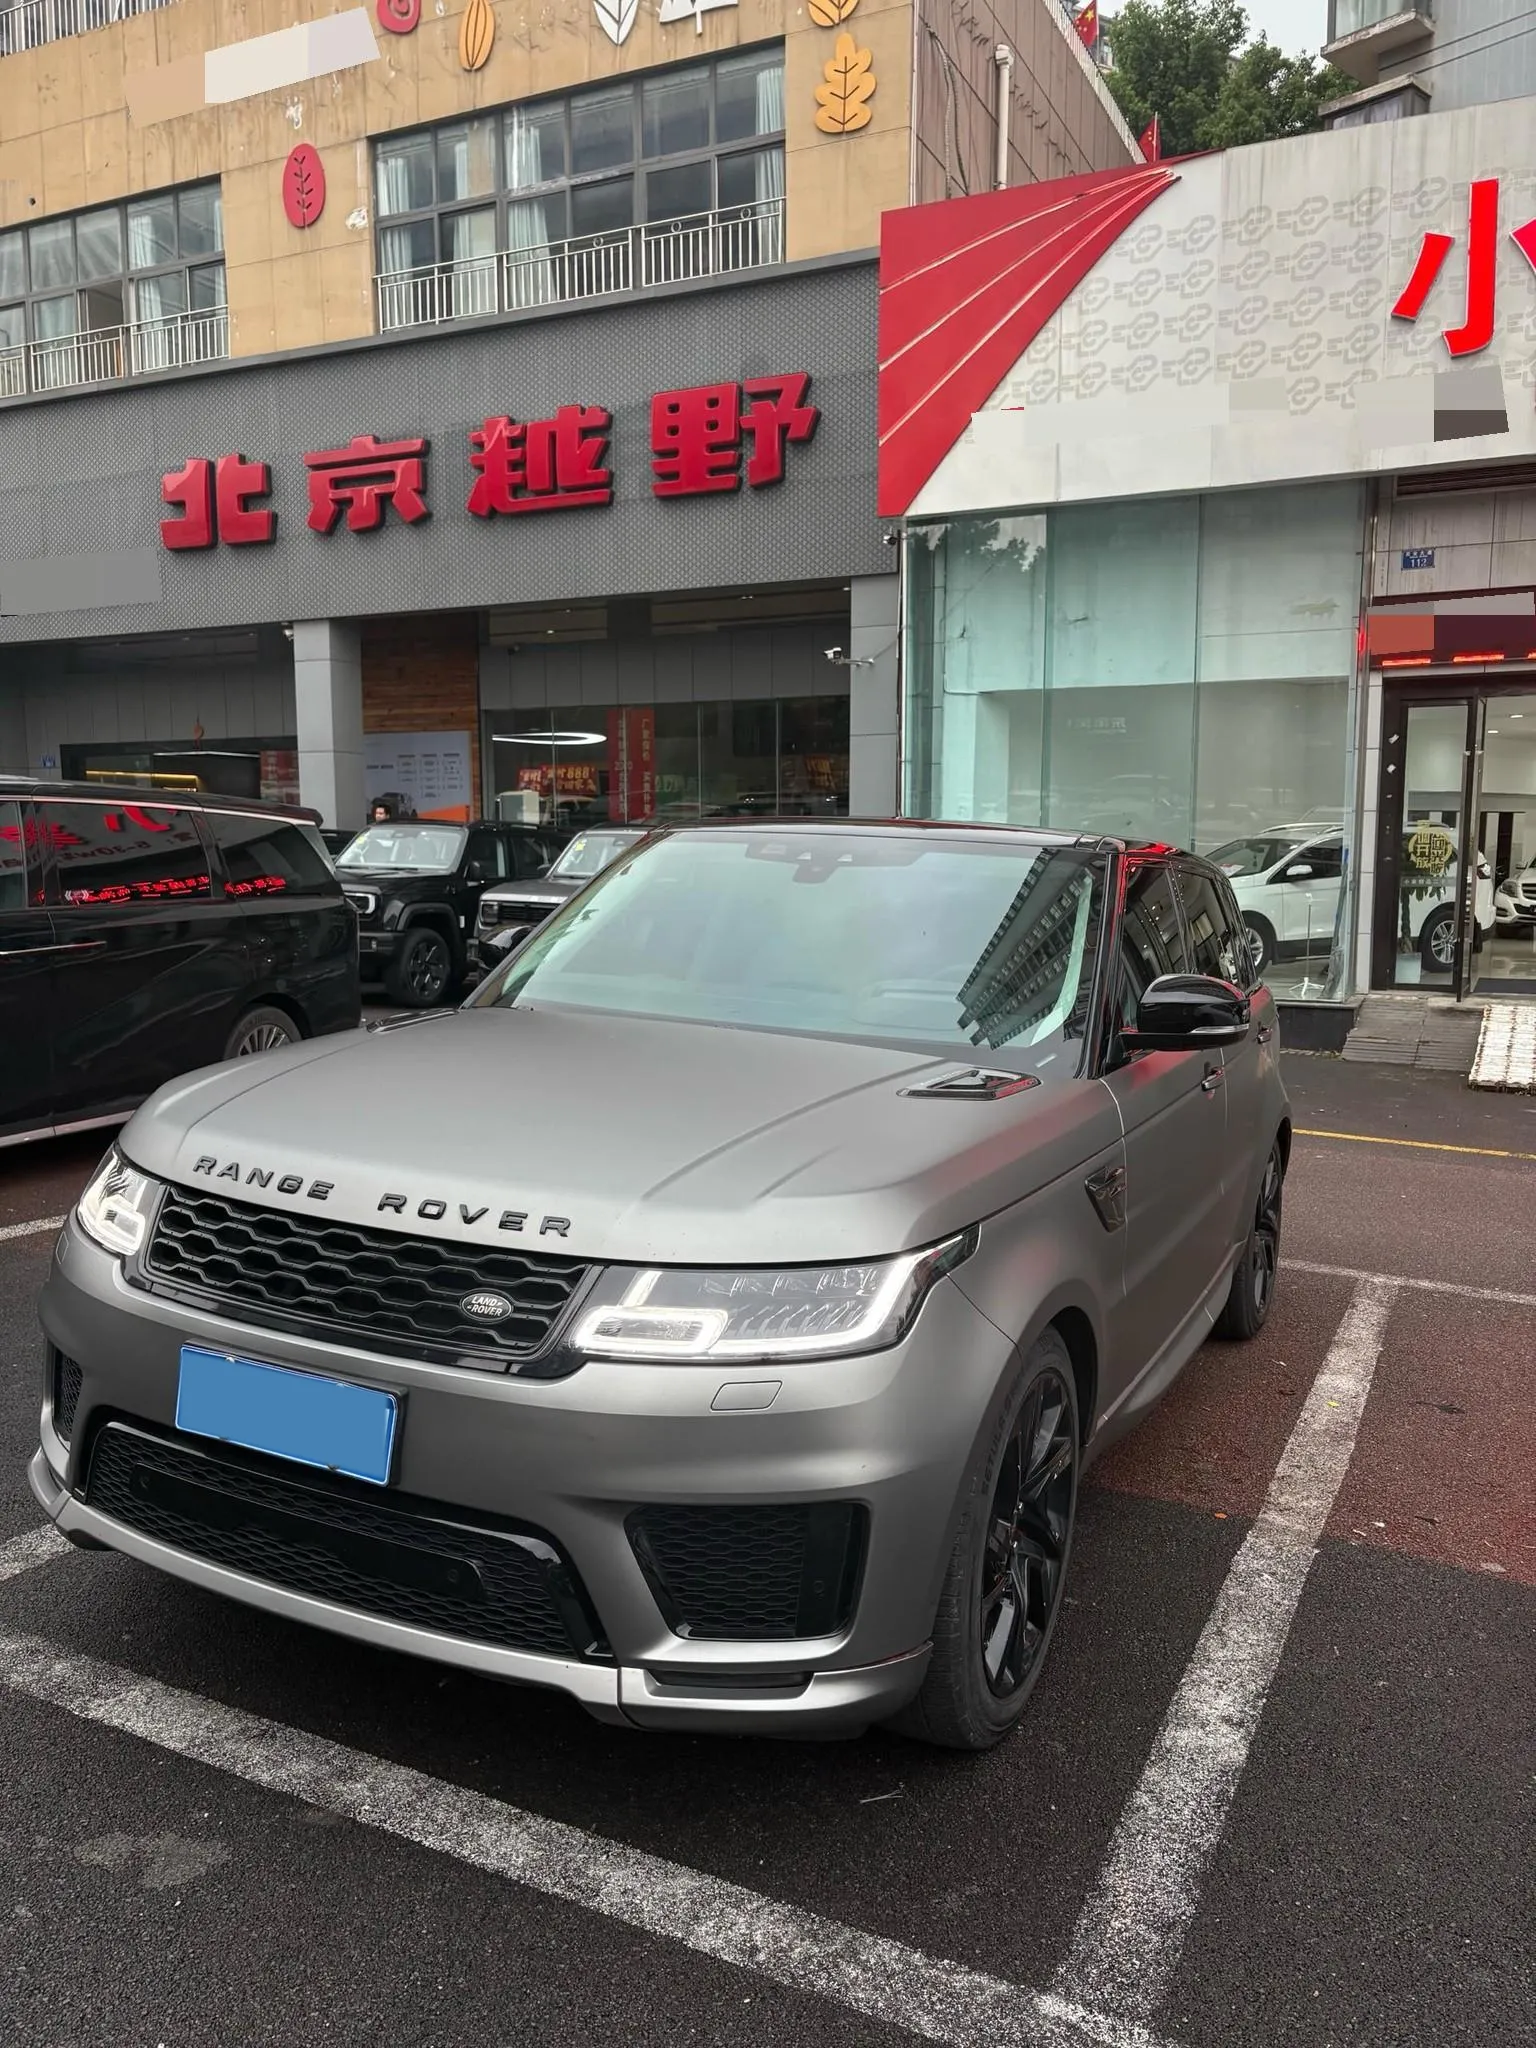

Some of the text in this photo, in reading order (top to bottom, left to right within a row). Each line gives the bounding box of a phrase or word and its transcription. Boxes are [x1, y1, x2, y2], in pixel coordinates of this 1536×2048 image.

[160, 371, 821, 551] 北京越野
[193, 1155, 573, 1239] RANGE ROVER
[471, 1296, 497, 1306] LAND
[471, 1305, 503, 1316] ROVER
